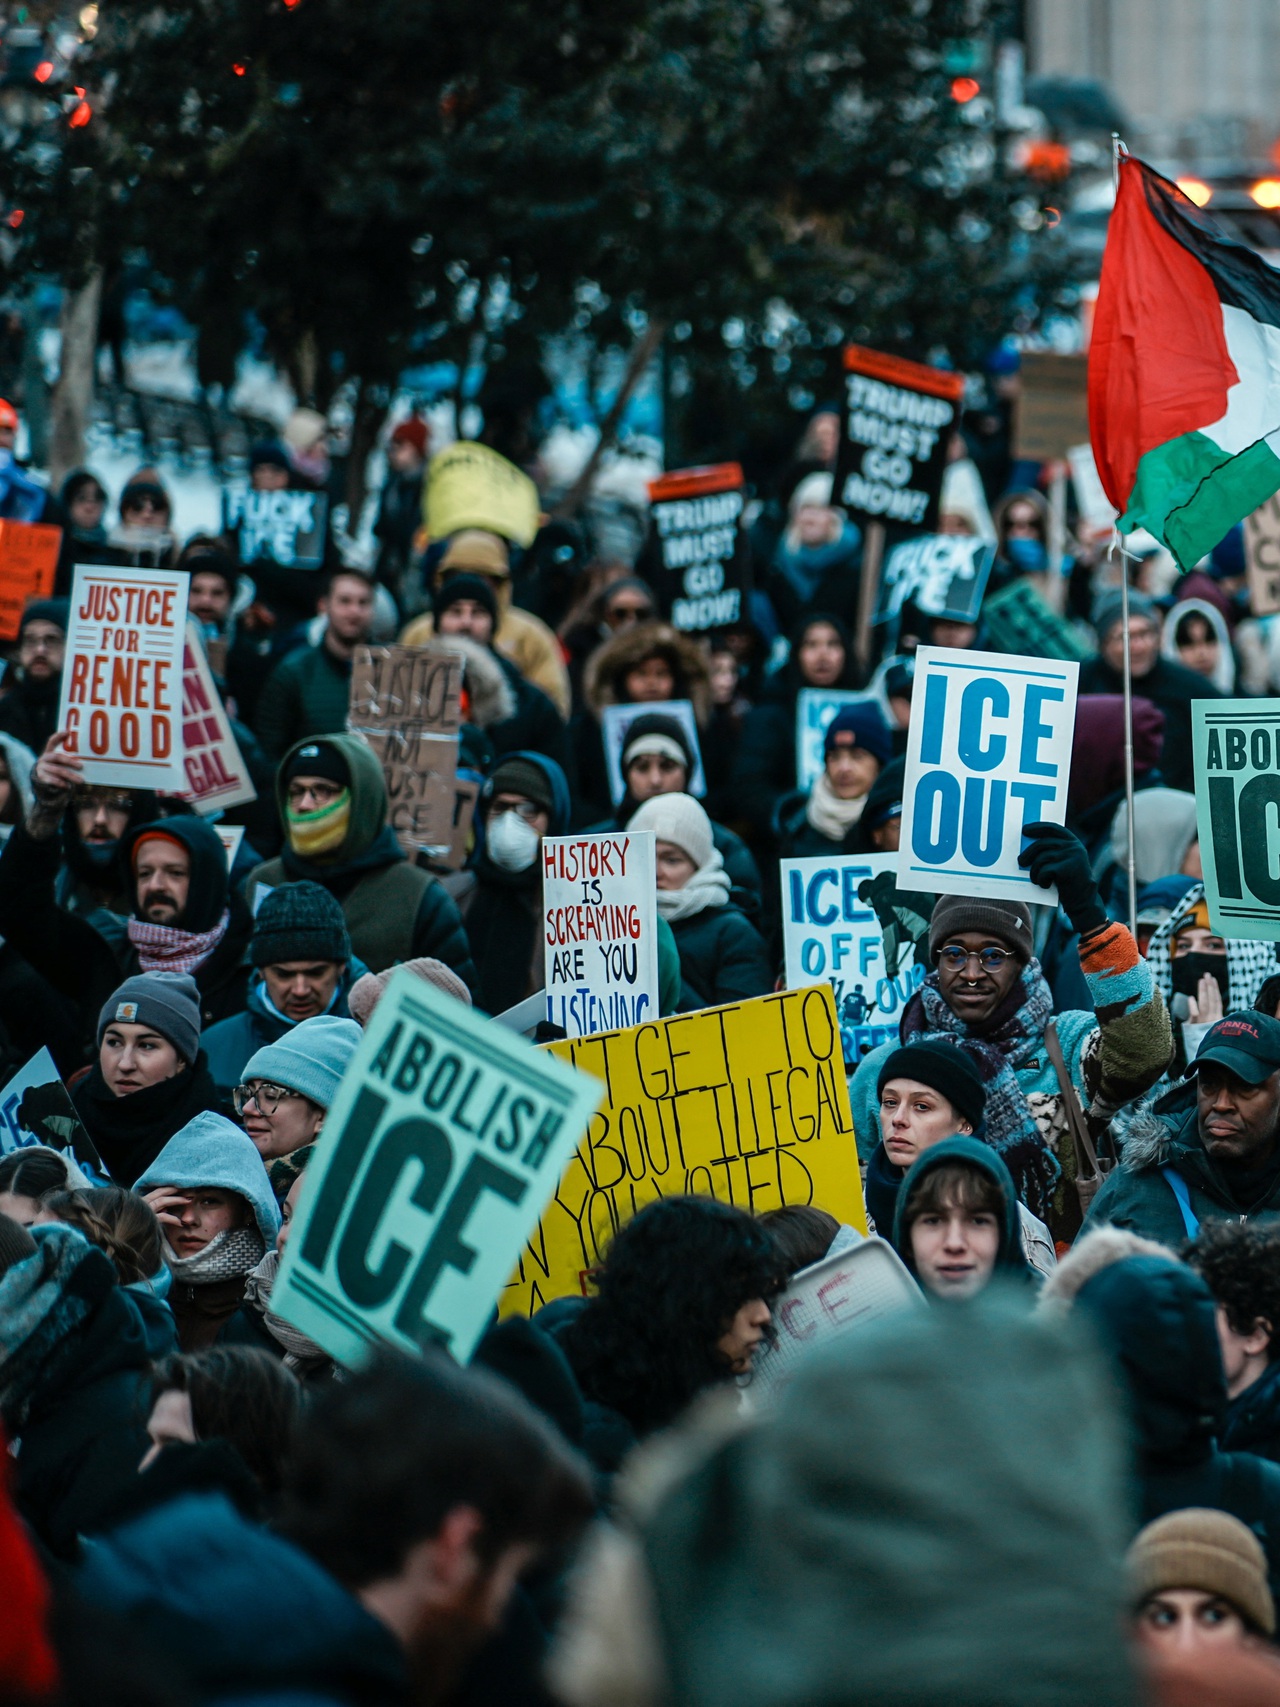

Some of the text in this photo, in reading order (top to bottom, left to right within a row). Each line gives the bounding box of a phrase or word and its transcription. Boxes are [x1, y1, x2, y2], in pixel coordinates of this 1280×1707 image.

[846, 374, 953, 427] TRUMP
[848, 411, 939, 462] MUST
[861, 449, 912, 486] GO
[227, 490, 316, 533] FUCK
[654, 492, 744, 537] TRUMP
[843, 473, 929, 524] NOW!
[664, 527, 737, 570] MUST
[683, 560, 725, 597] GO
[79, 585, 177, 627] JUSTICE
[672, 589, 741, 631] NOW!
[100, 627, 140, 652] FOR
[68, 654, 171, 710] RENEE
[63, 707, 171, 758] GOOD
[920, 673, 1065, 778] ICE
[387, 770, 428, 799] UST
[911, 770, 1057, 871] OUT
[544, 837, 630, 882] HISTORY
[581, 879, 603, 906] IS
[789, 866, 875, 927] ICE
[546, 904, 641, 946] SCREAMING
[552, 943, 638, 984] ARE YOU
[801, 933, 881, 977] OFF
[876, 963, 926, 1014] OUR
[635, 1007, 741, 1100] GET
[763, 990, 835, 1068] TO
[368, 1019, 567, 1173] ABOLISH
[700, 1060, 854, 1165] ILLEGAL
[300, 1082, 531, 1354] ICE
